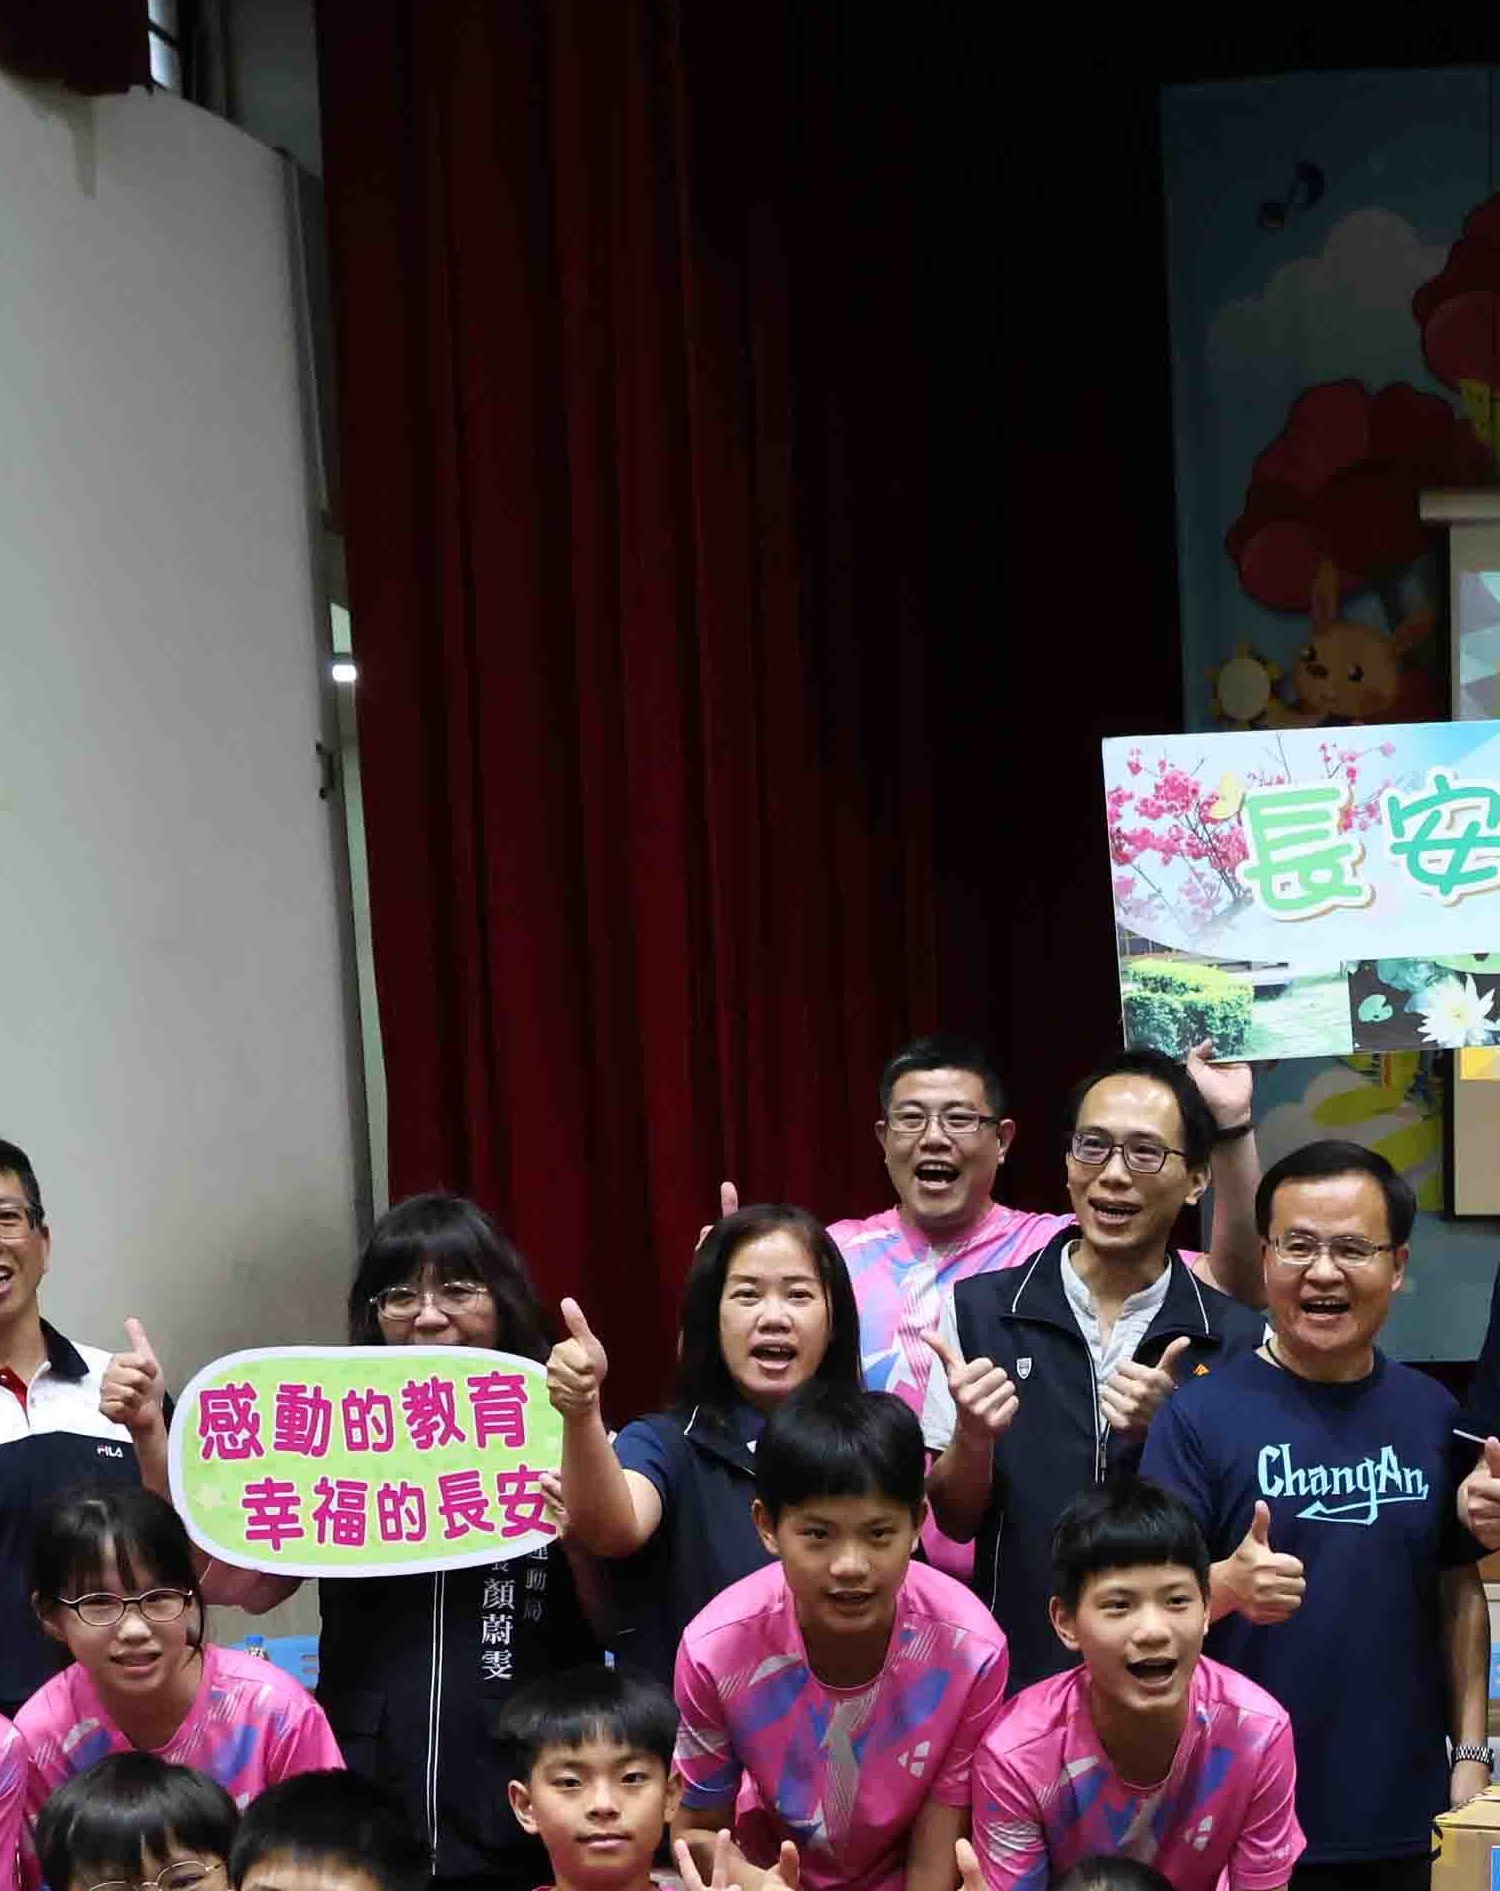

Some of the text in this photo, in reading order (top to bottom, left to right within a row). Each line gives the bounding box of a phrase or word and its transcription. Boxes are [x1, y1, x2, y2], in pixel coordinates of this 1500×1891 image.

[96, 1445, 124, 1458] FILA
[197, 1370, 528, 1462] 感動的教育
[242, 1464, 559, 1551] 幸福的長安
[1257, 1444, 1429, 1525] ChangAn
[481, 1578, 517, 1680] 顏蔚雯
